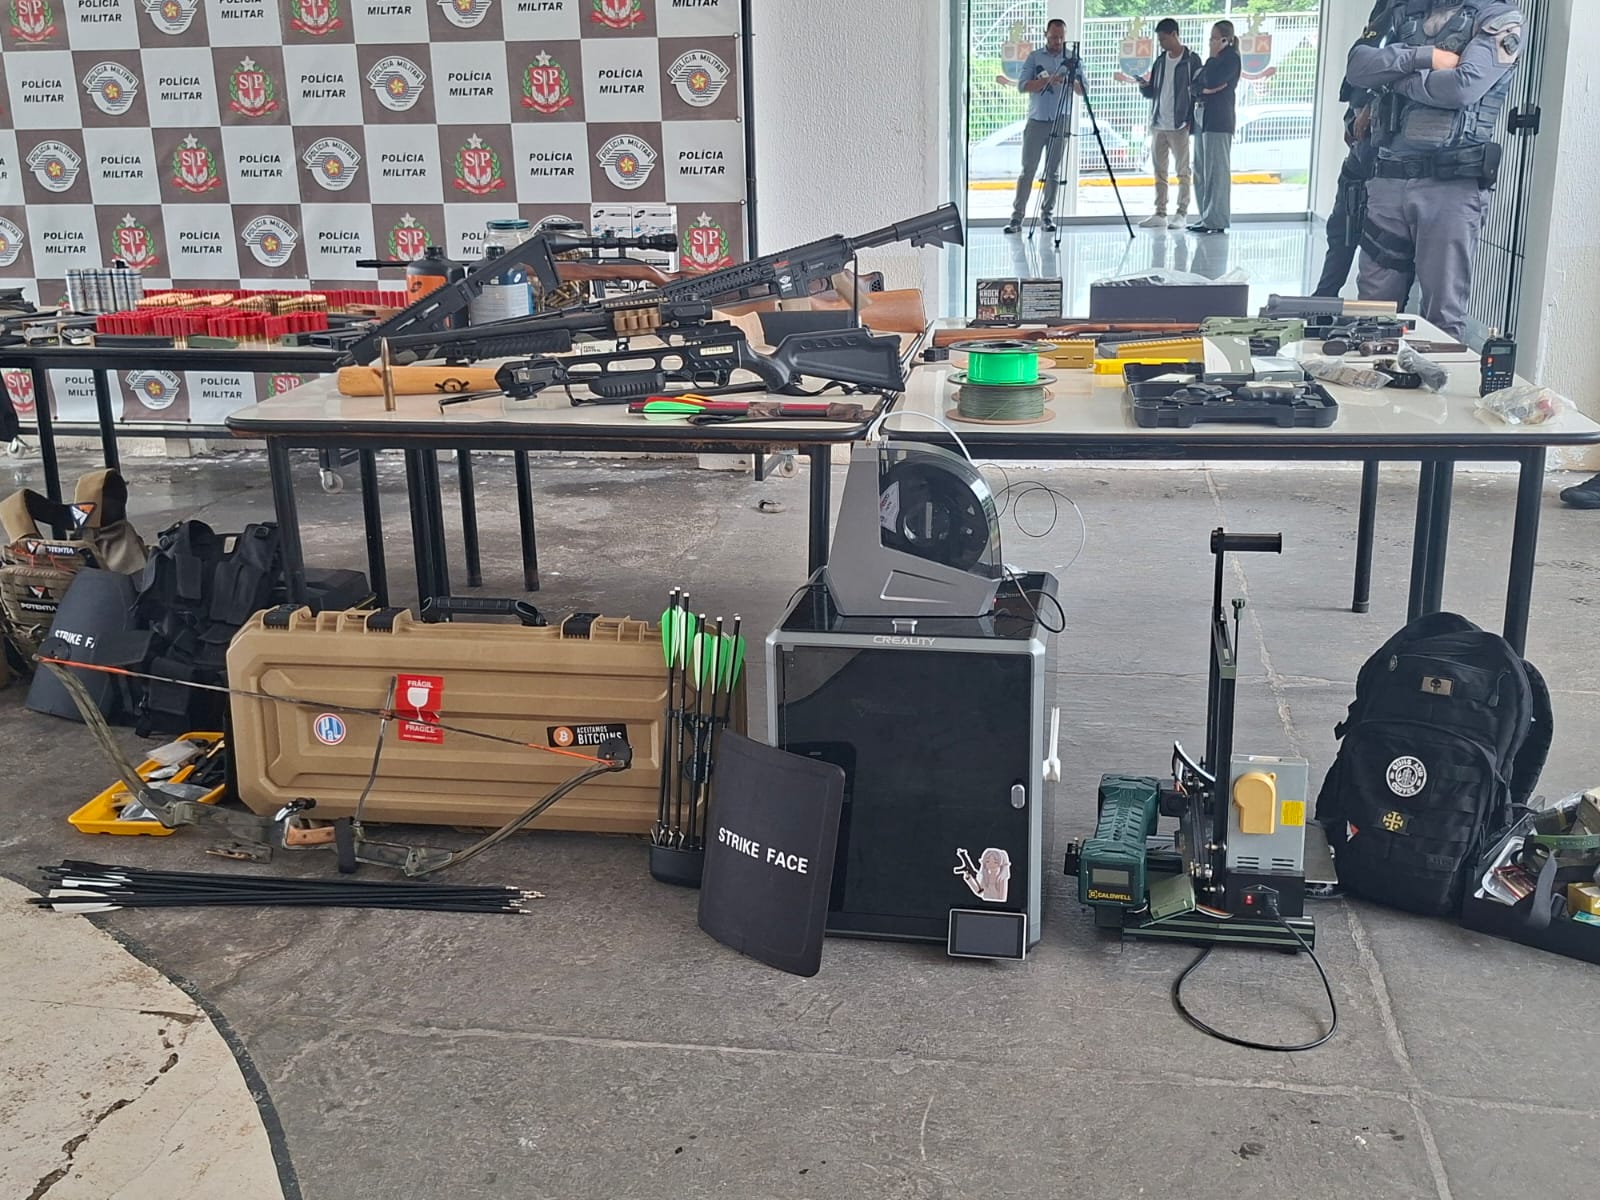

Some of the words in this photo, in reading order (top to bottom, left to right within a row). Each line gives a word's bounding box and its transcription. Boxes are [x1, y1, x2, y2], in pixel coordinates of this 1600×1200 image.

[368, 6, 411, 15] MILITAR
[518, 2, 562, 11] MILITAR
[81, 14, 121, 22] MILITAR
[222, 10, 263, 18] MILITAR
[700, 55, 724, 74] MILITAR
[448, 70, 491, 81] POLÍCIA
[599, 67, 642, 78] POLÍCIA
[160, 77, 200, 86] POLÍCIA
[301, 73, 343, 83] POLÍCIA
[22, 78, 61, 88] POLÍCIA
[450, 87, 493, 96] MILITAR
[600, 85, 644, 93] MILITAR
[24, 94, 64, 102] MILITAR
[161, 92, 202, 100] MILITAR
[303, 90, 345, 98] MILITAR
[240, 153, 280, 163] POLÍCIA
[382, 152, 424, 162] POLÍCIA
[530, 151, 572, 161] POLÍCIA
[679, 149, 723, 159] POLÍCIA
[101, 155, 140, 164] POLÍCIA
[103, 170, 143, 178] MILITAR
[241, 169, 282, 177] MILITAR
[531, 167, 574, 176] MILITAR
[680, 166, 725, 174] MILITAR
[44, 230, 83, 239] POLÍCIA
[180, 230, 220, 239] POLÍCIA
[319, 230, 359, 239] POLÍCIA
[201, 376, 240, 385] POLÍCIA
[873, 635, 936, 646] CREALITY
[719, 827, 760, 859] STRIKE
[766, 847, 809, 874] FACE
